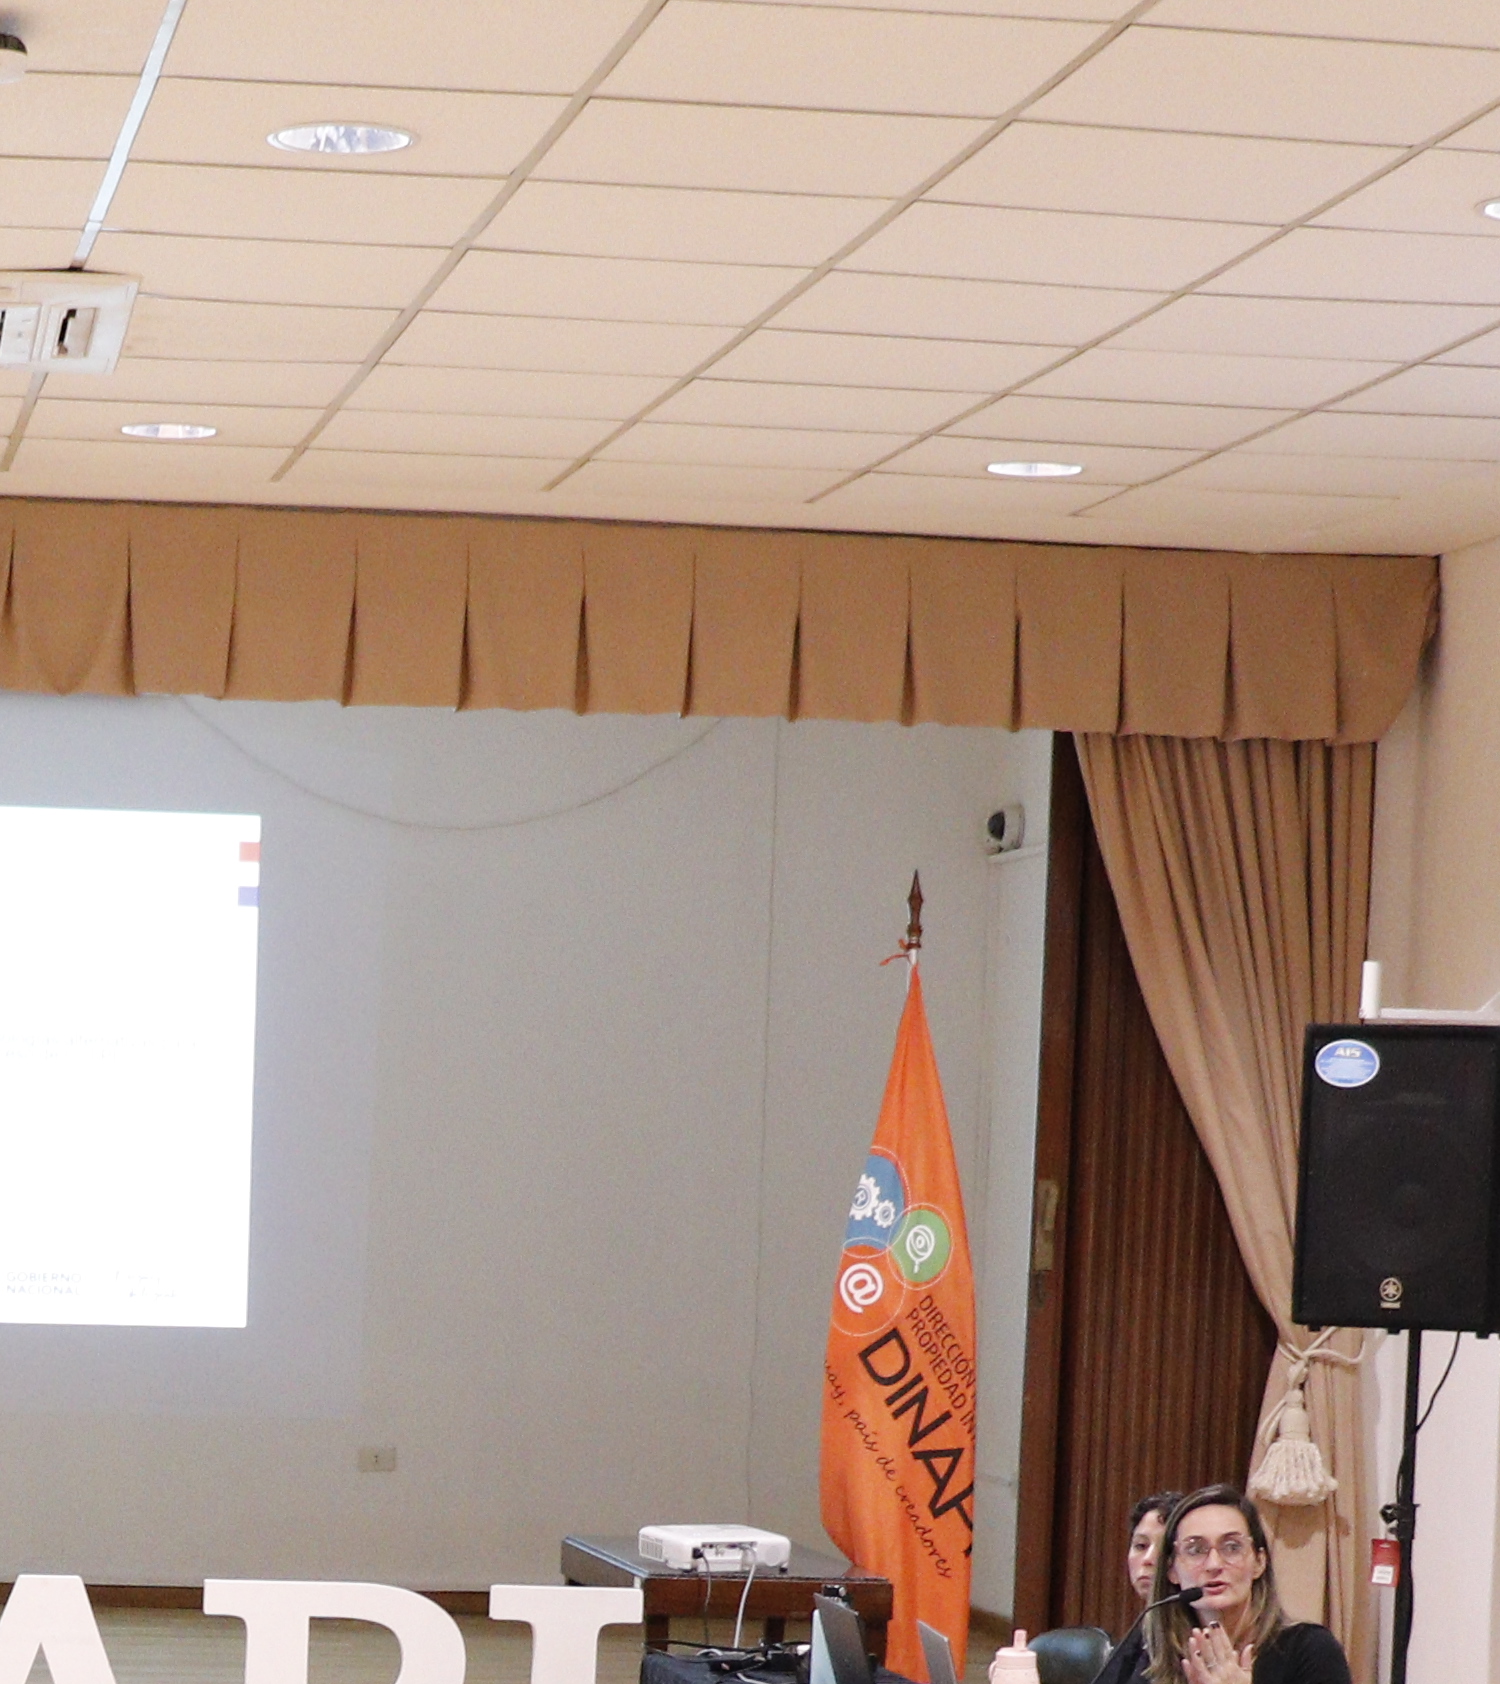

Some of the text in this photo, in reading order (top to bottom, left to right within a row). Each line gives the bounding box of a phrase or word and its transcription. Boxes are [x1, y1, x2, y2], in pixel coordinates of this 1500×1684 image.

[6, 1271, 82, 1283] GOBIERNO
[6, 1285, 80, 1296] NACIONAL
[905, 1308, 966, 1410] PROPIEDAD
